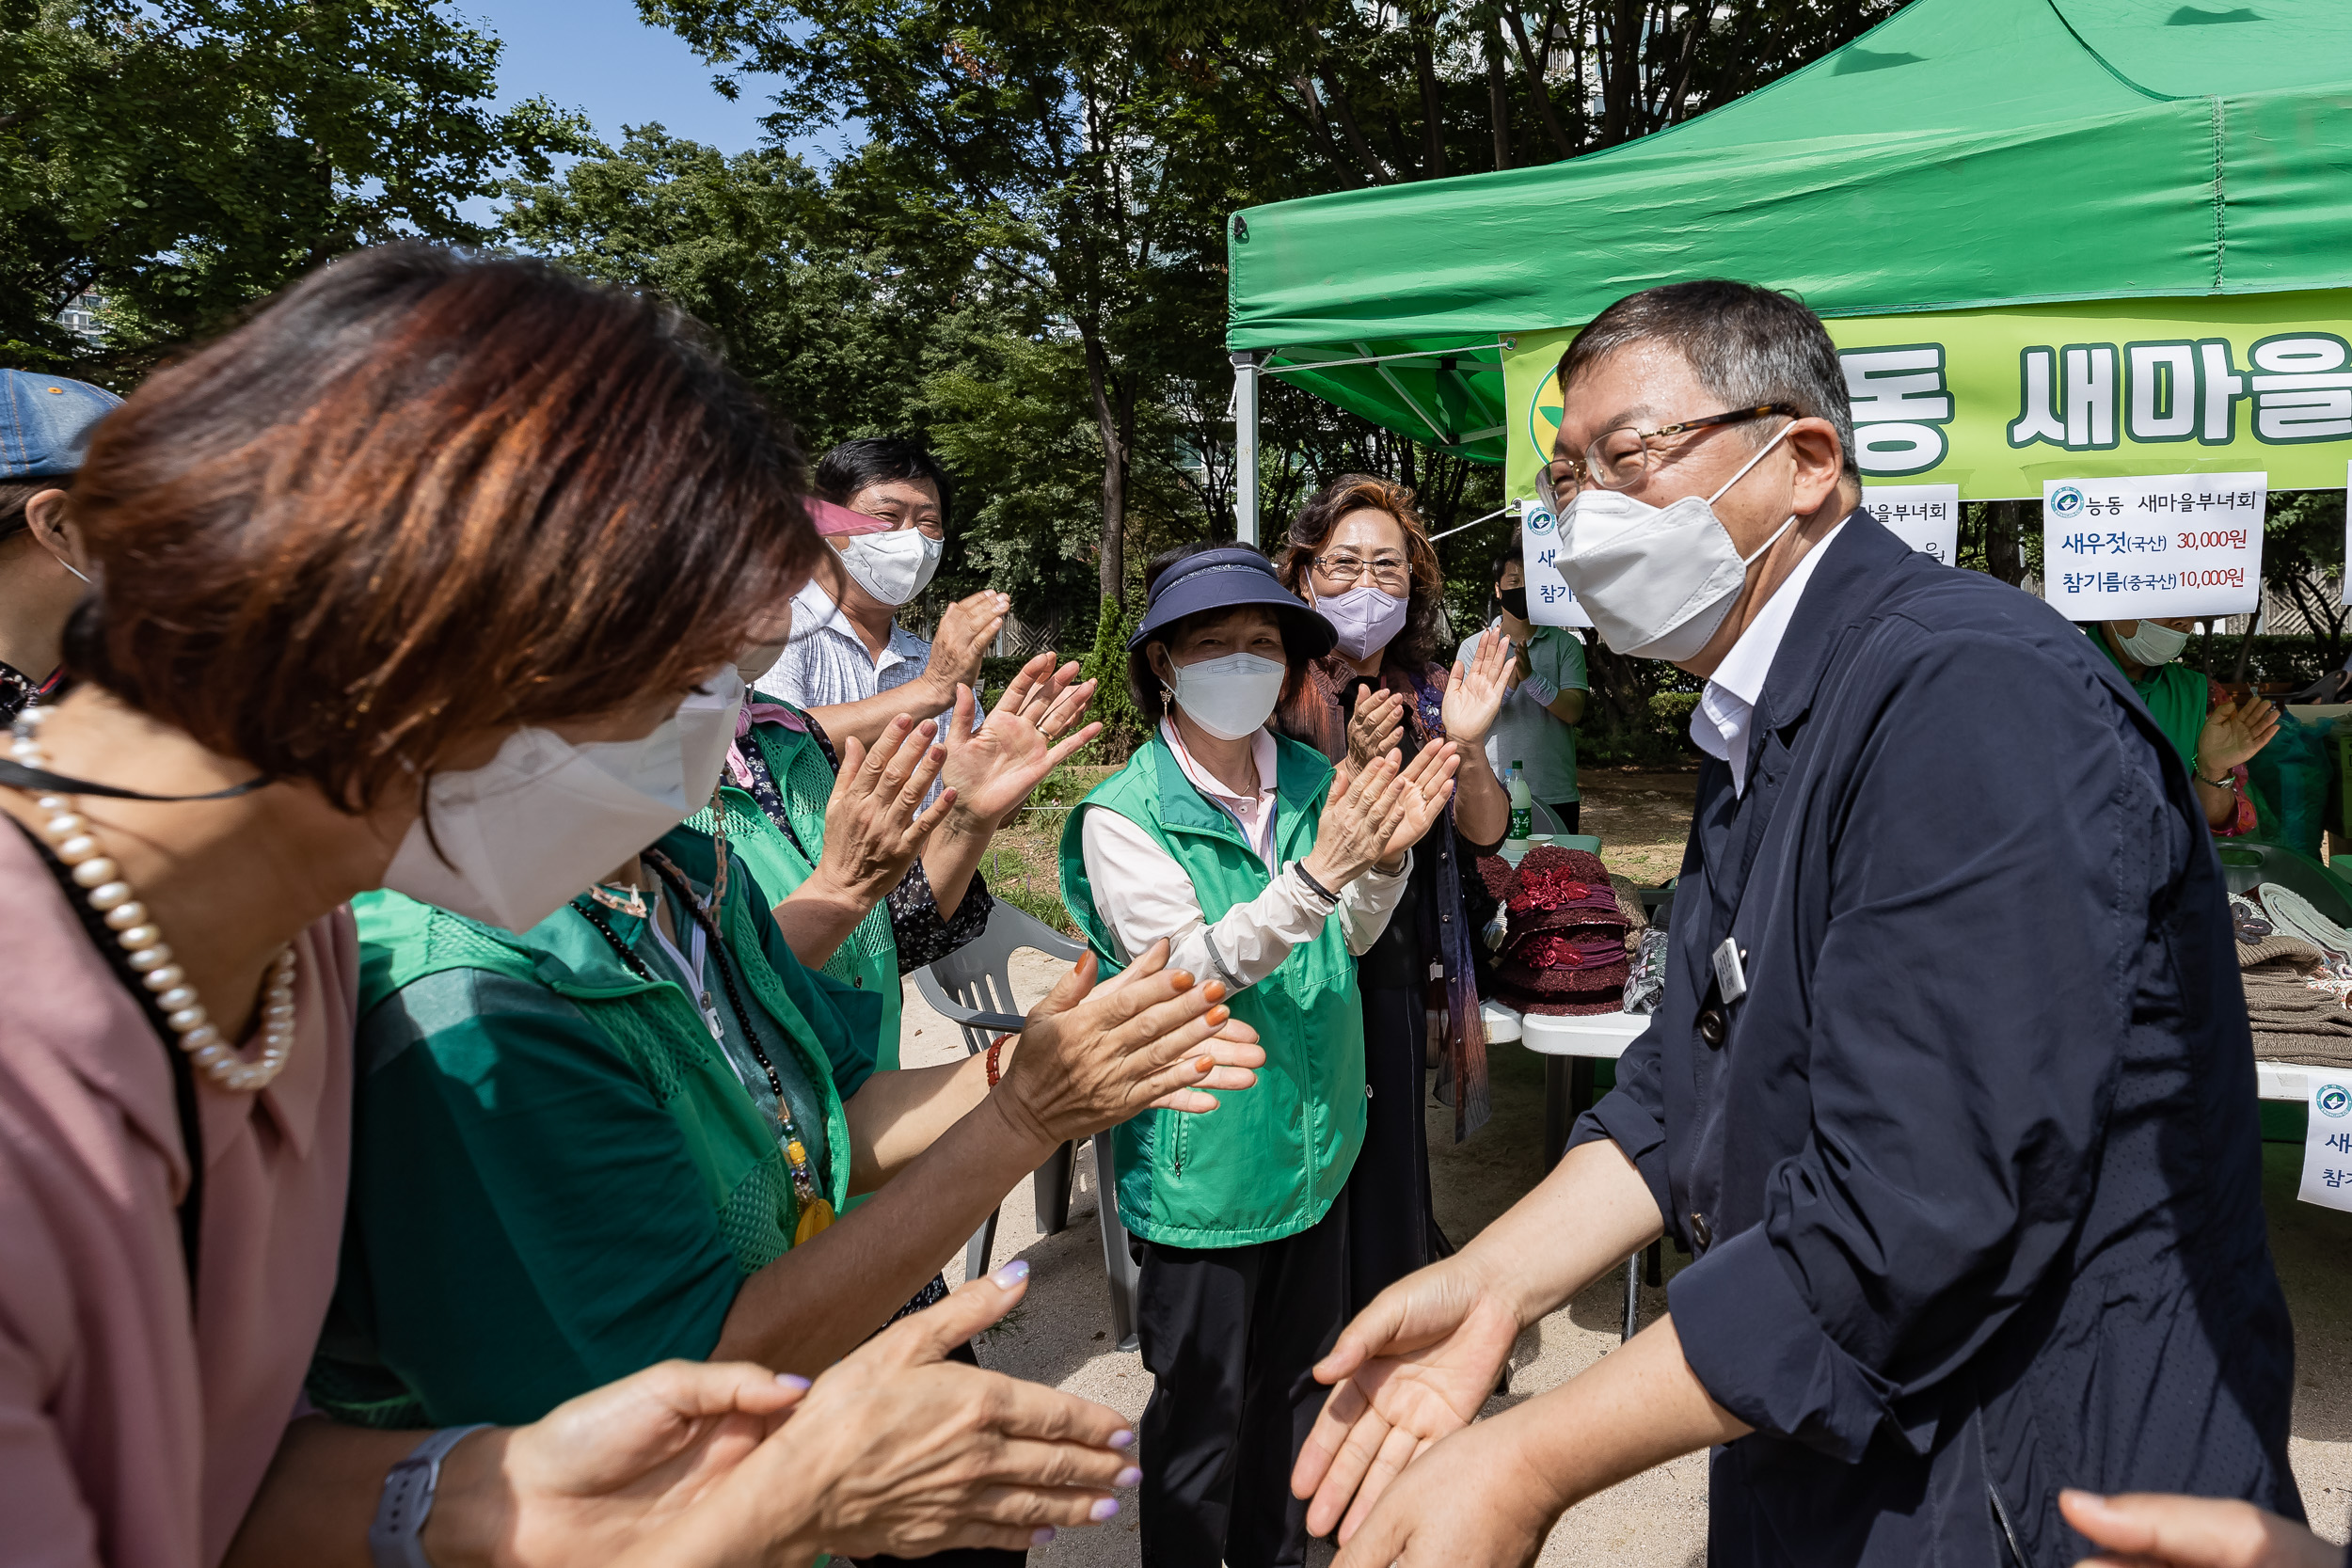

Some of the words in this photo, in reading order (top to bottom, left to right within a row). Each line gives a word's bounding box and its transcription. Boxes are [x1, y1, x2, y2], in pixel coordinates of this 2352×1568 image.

[2007, 331, 2352, 451] 새마을
[2085, 496, 2124, 516] 능동
[2137, 490, 2257, 514] 새마을부녀회
[2061, 531, 2168, 555] 새우젓(국산)
[2176, 529, 2248, 551] 30,000원
[2062, 570, 2178, 594] 참기름(중국산)
[2179, 567, 2245, 590] 10,000원
[1540, 584, 1579, 604] 참기
[2325, 1132, 2352, 1154] 새
